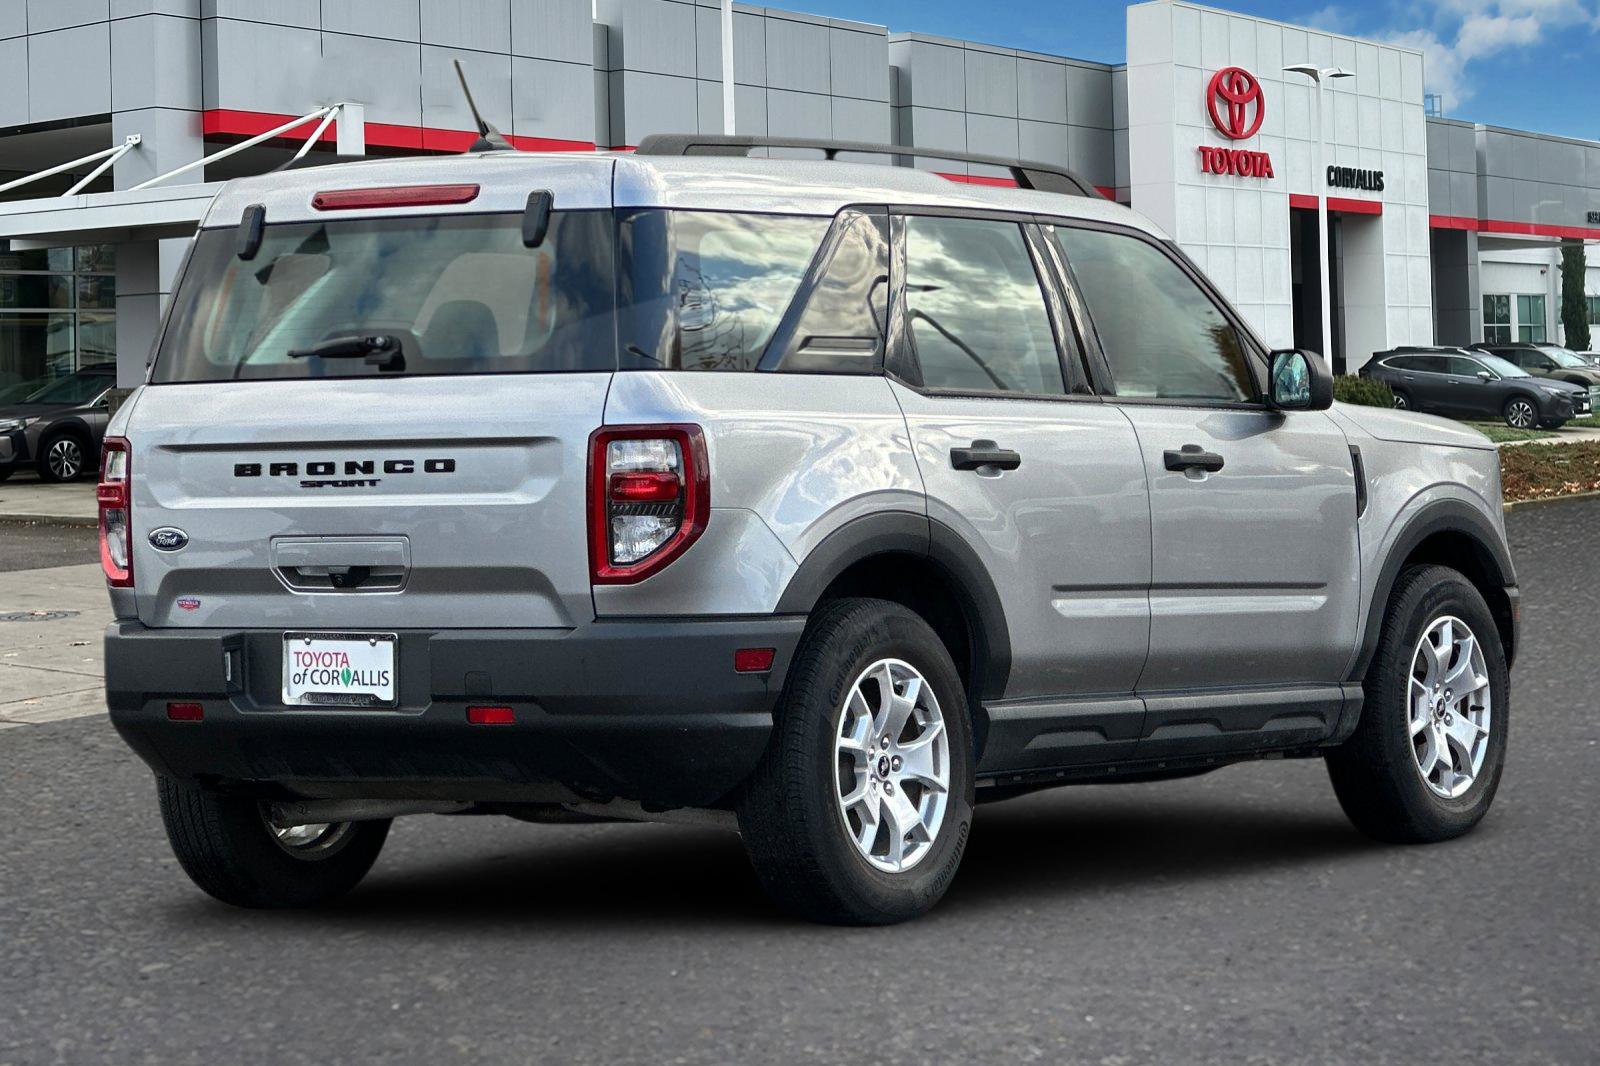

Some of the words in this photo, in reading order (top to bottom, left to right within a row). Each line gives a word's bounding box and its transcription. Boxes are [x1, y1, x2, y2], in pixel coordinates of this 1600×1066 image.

[1199, 146, 1275, 179] TOYOTA
[1326, 165, 1385, 191] CORVALLIS
[233, 458, 456, 477] BRONCO
[300, 478, 382, 488] SPORT
[293, 651, 350, 668] TOYOTA
[292, 668, 309, 685] of
[310, 668, 390, 687] CORVALLIS
